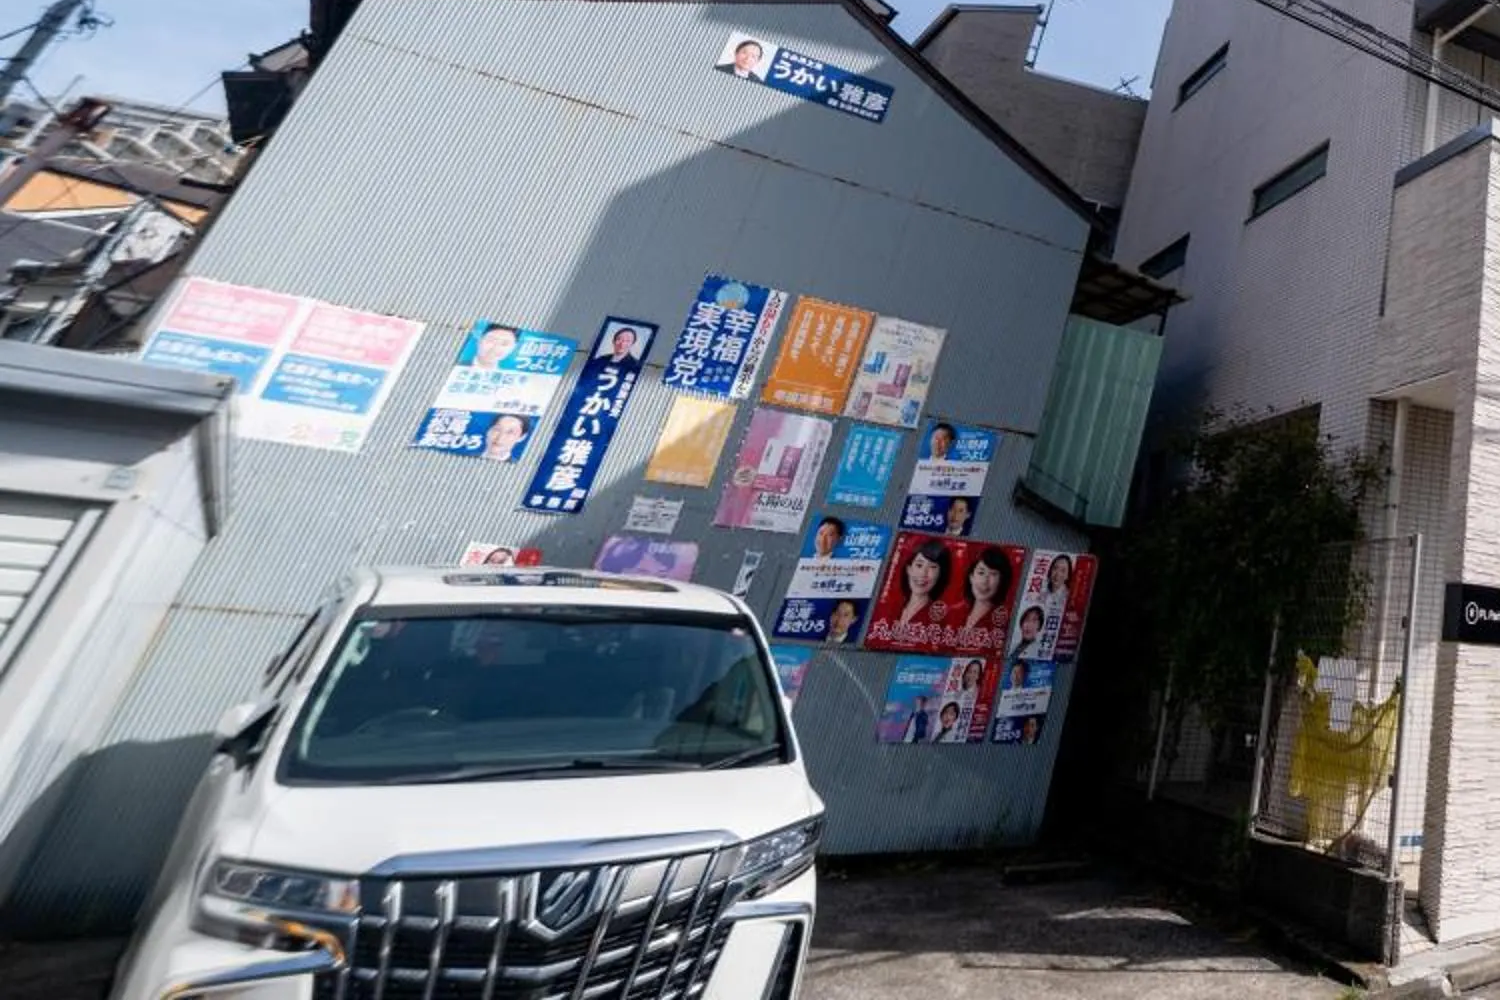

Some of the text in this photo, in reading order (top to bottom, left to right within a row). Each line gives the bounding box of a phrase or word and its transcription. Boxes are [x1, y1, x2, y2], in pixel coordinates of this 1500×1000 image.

[773, 57, 889, 112] うかい雅彦
[665, 301, 725, 386] 実現党
[712, 308, 756, 364] 幸福
[516, 357, 561, 373] つよし
[545, 367, 619, 491] うかい雅彦
